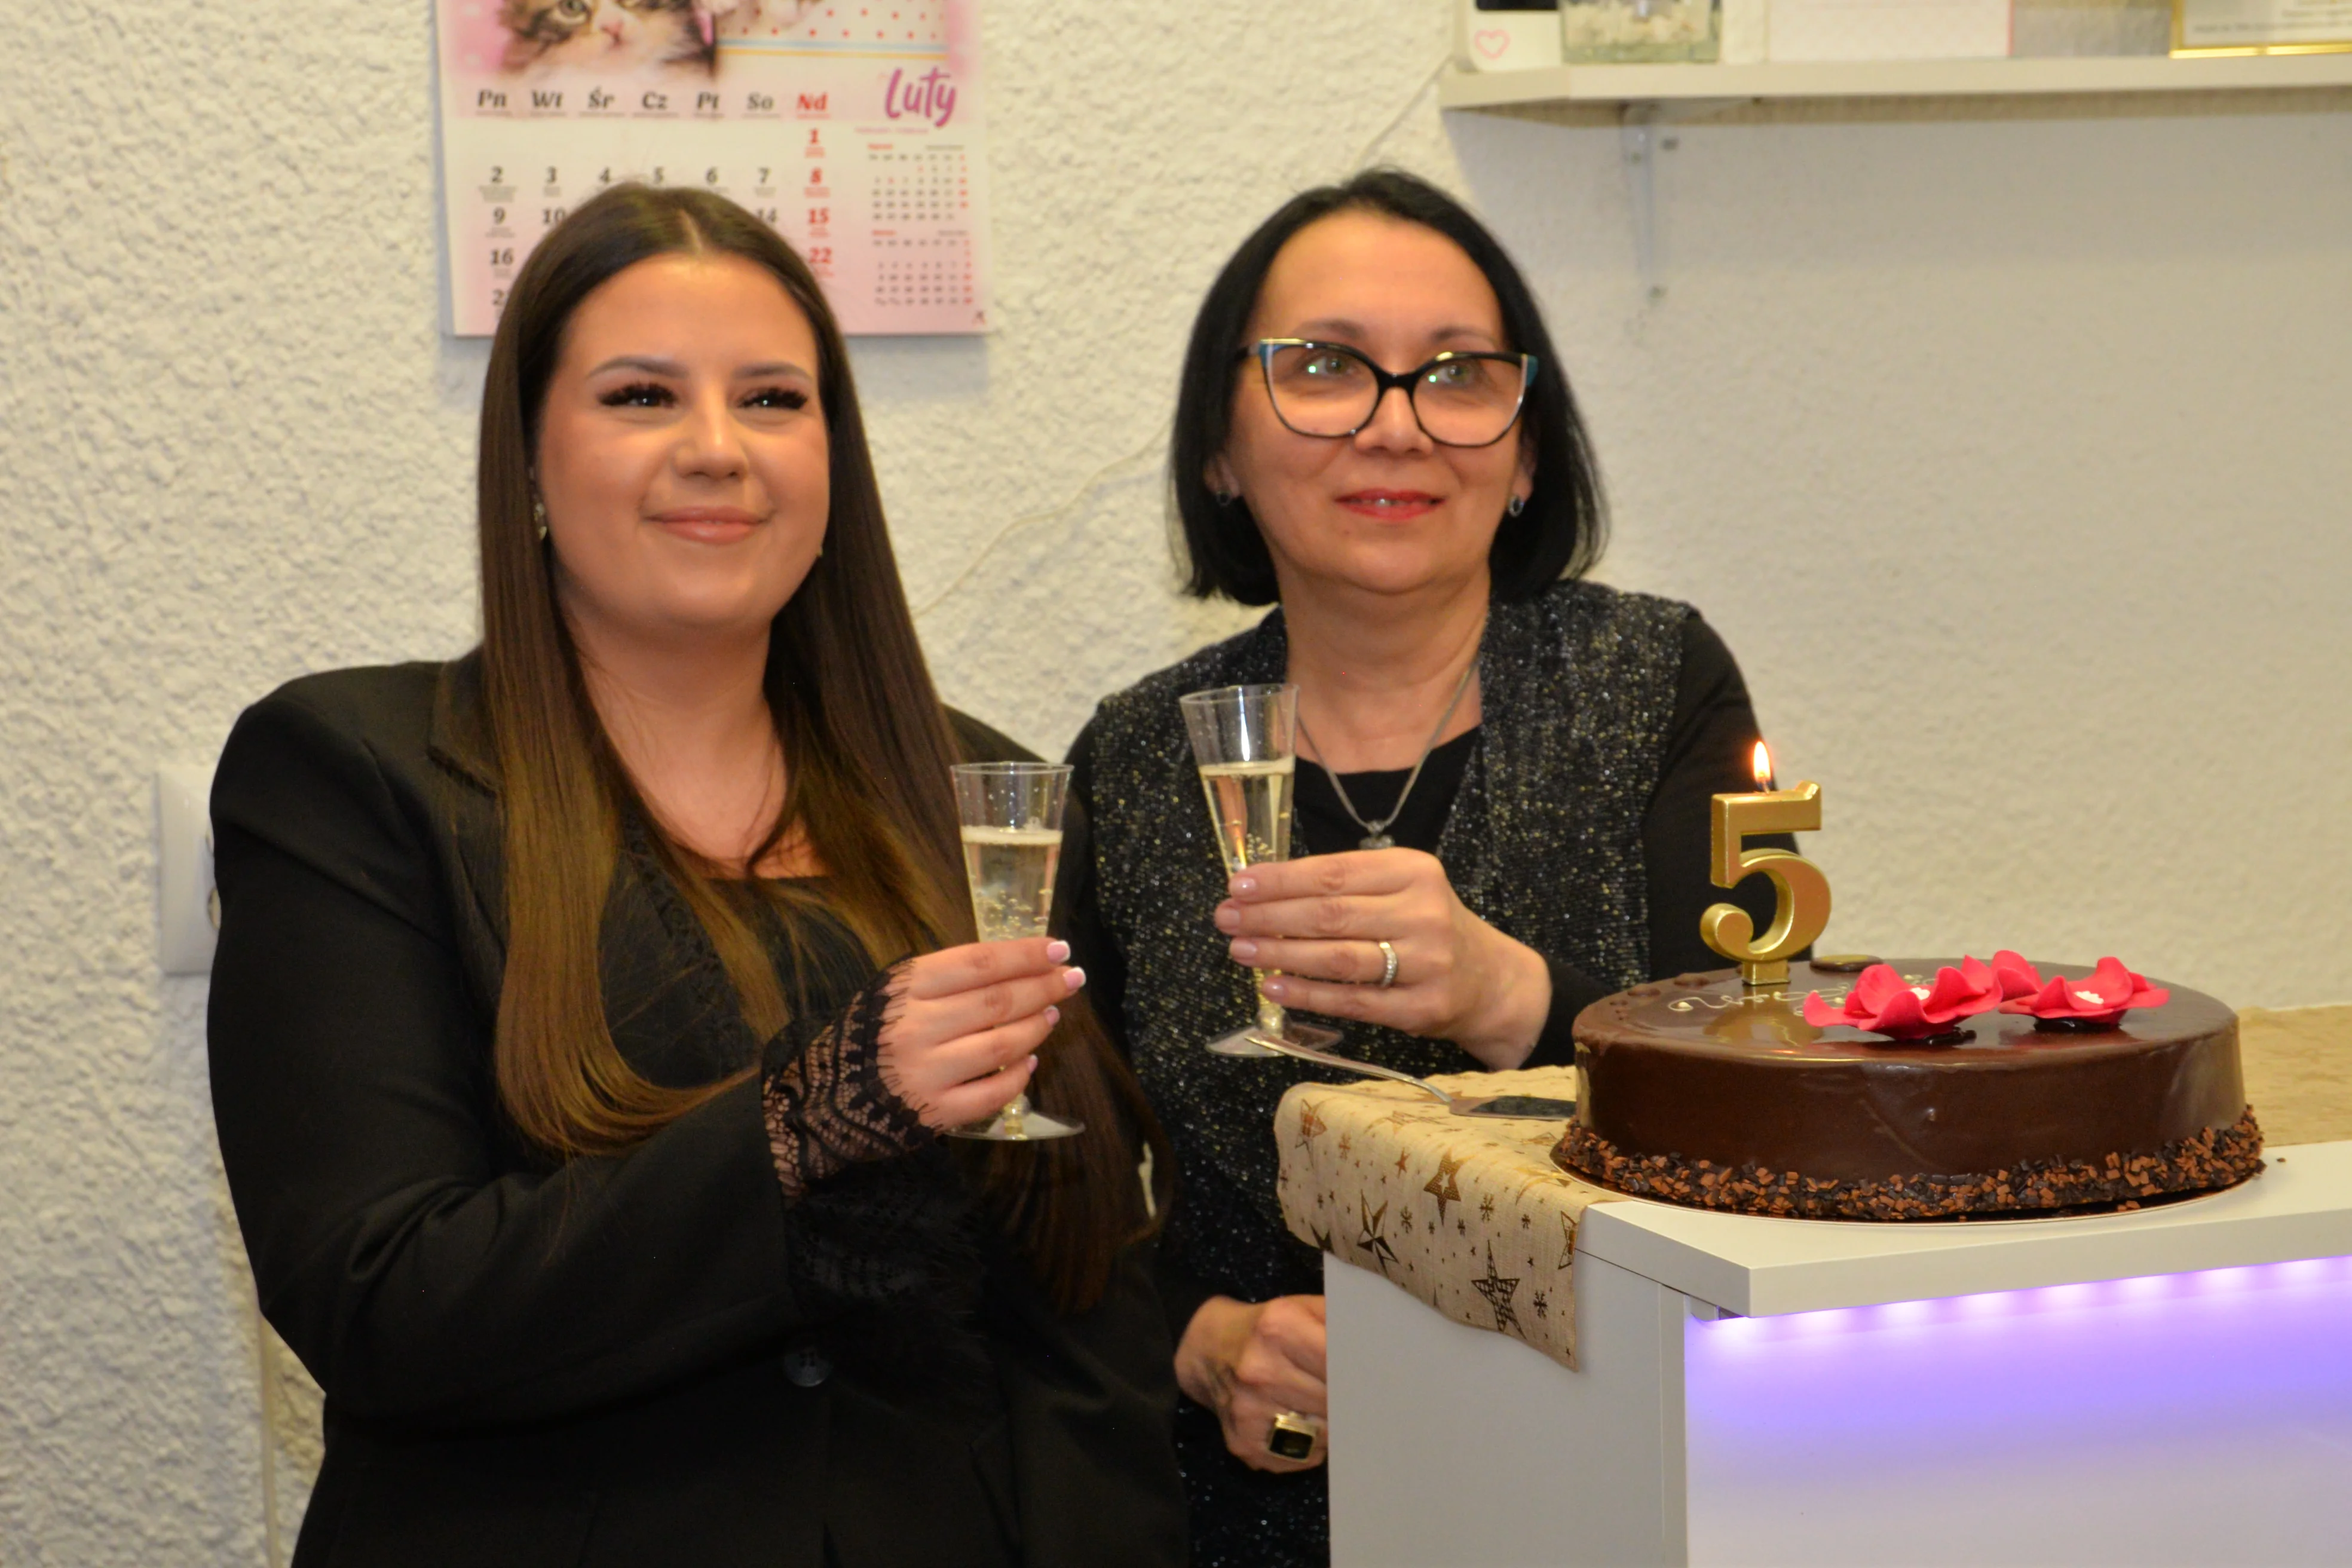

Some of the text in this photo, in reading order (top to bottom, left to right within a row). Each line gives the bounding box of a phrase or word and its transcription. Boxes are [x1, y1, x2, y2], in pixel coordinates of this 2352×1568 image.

[477, 86, 828, 111] Pn Wt Śr Cz Pt So Nd
[885, 67, 957, 127] Luty
[810, 128, 819, 145] 1
[491, 166, 822, 185] 2 3 4 5 6 7 8
[493, 207, 506, 225] 9
[808, 209, 829, 225] 15
[490, 248, 831, 267] 16 22
[1700, 780, 1832, 963] 5
